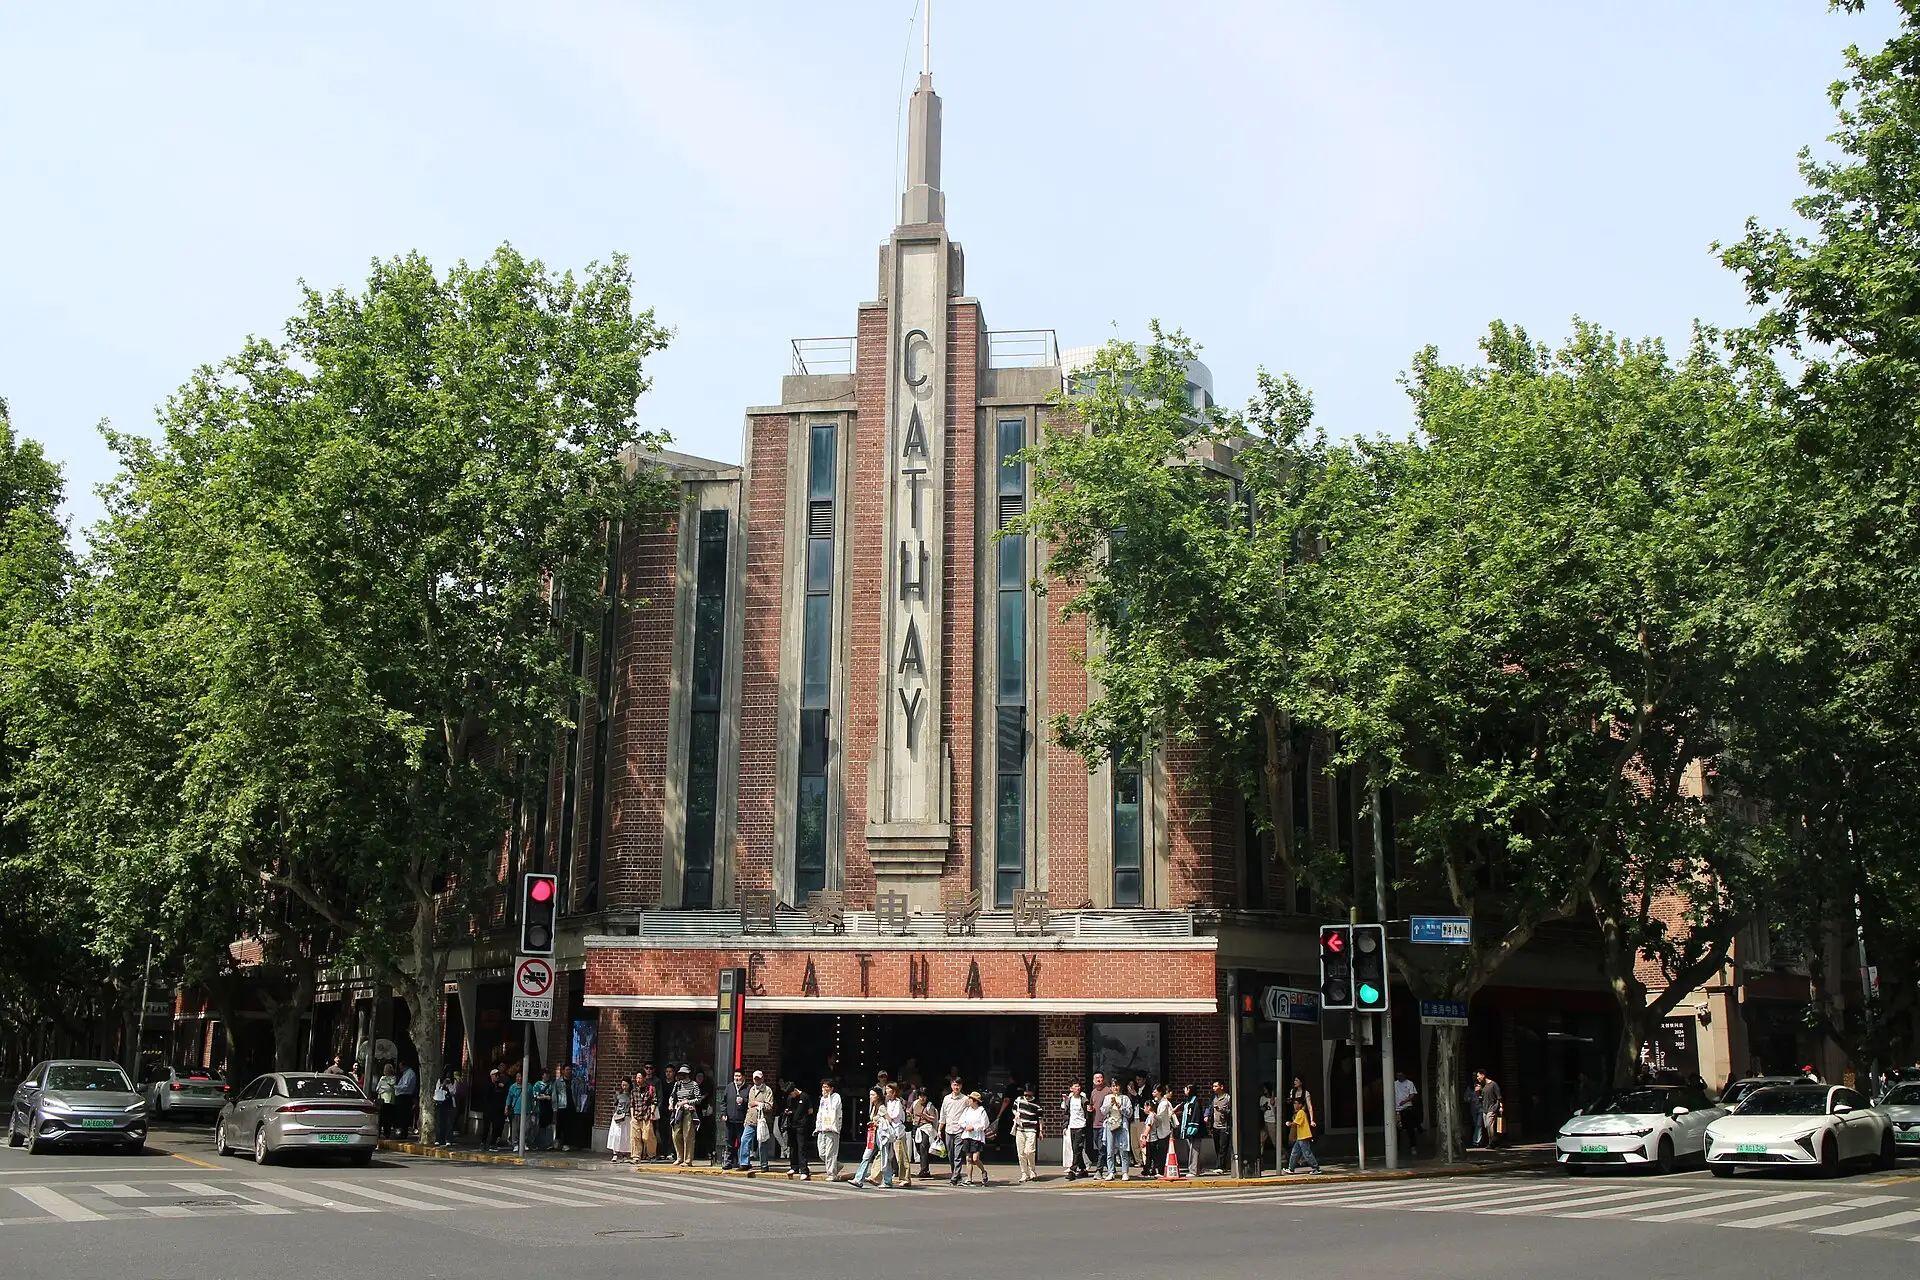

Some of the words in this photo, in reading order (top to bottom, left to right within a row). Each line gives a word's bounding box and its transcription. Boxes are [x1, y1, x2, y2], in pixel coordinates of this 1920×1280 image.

[898, 329, 929, 749] CATHAY
[740, 887, 1051, 928] 国泰电影院
[749, 952, 1038, 996] CATHAY
[514, 1008, 549, 1018] 大型号牌
